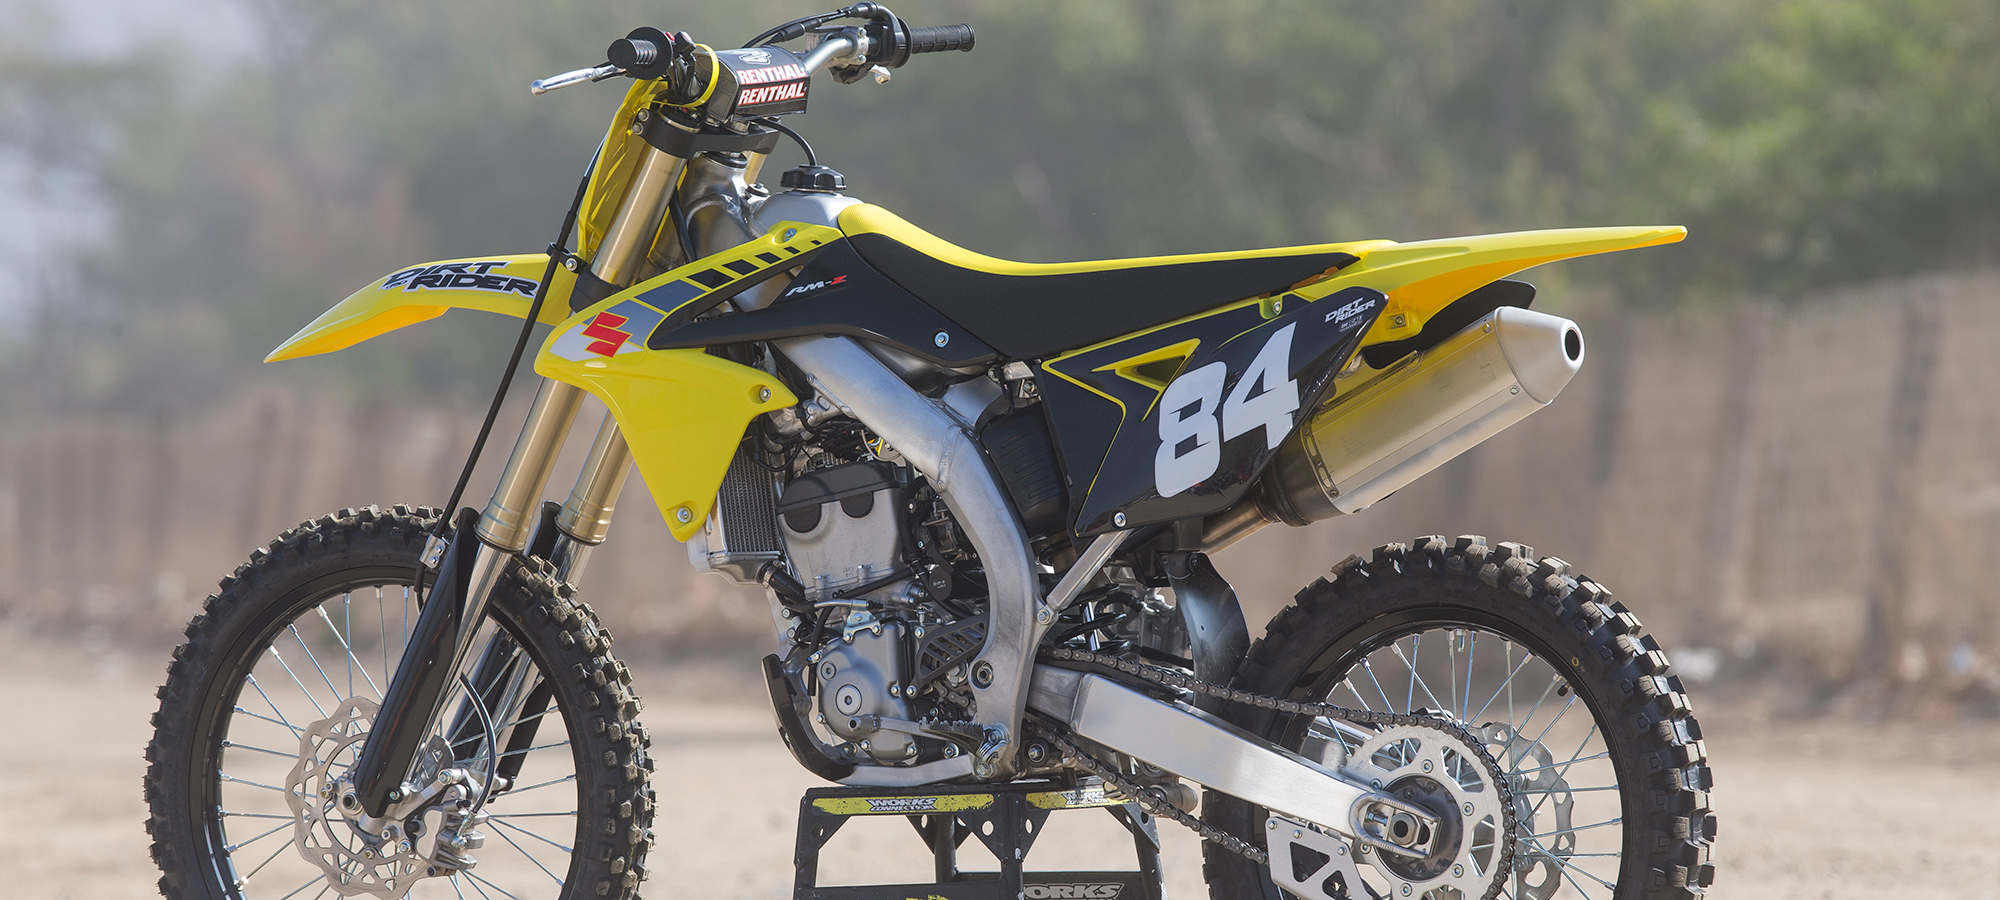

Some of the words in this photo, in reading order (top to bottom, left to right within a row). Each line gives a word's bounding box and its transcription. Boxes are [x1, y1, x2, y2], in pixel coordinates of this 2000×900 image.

[737, 63, 807, 86] RENTHAL
[738, 81, 805, 106] RENTHAL
[384, 261, 508, 287] DIRT
[406, 273, 540, 297] RIDER
[785, 274, 848, 297] RM-Z
[1324, 297, 1363, 323] DIRT
[1334, 299, 1376, 324] RIDER
[1154, 320, 1301, 499] 84
[866, 797, 938, 806] WORKS
[1022, 884, 1122, 899] ORKS
